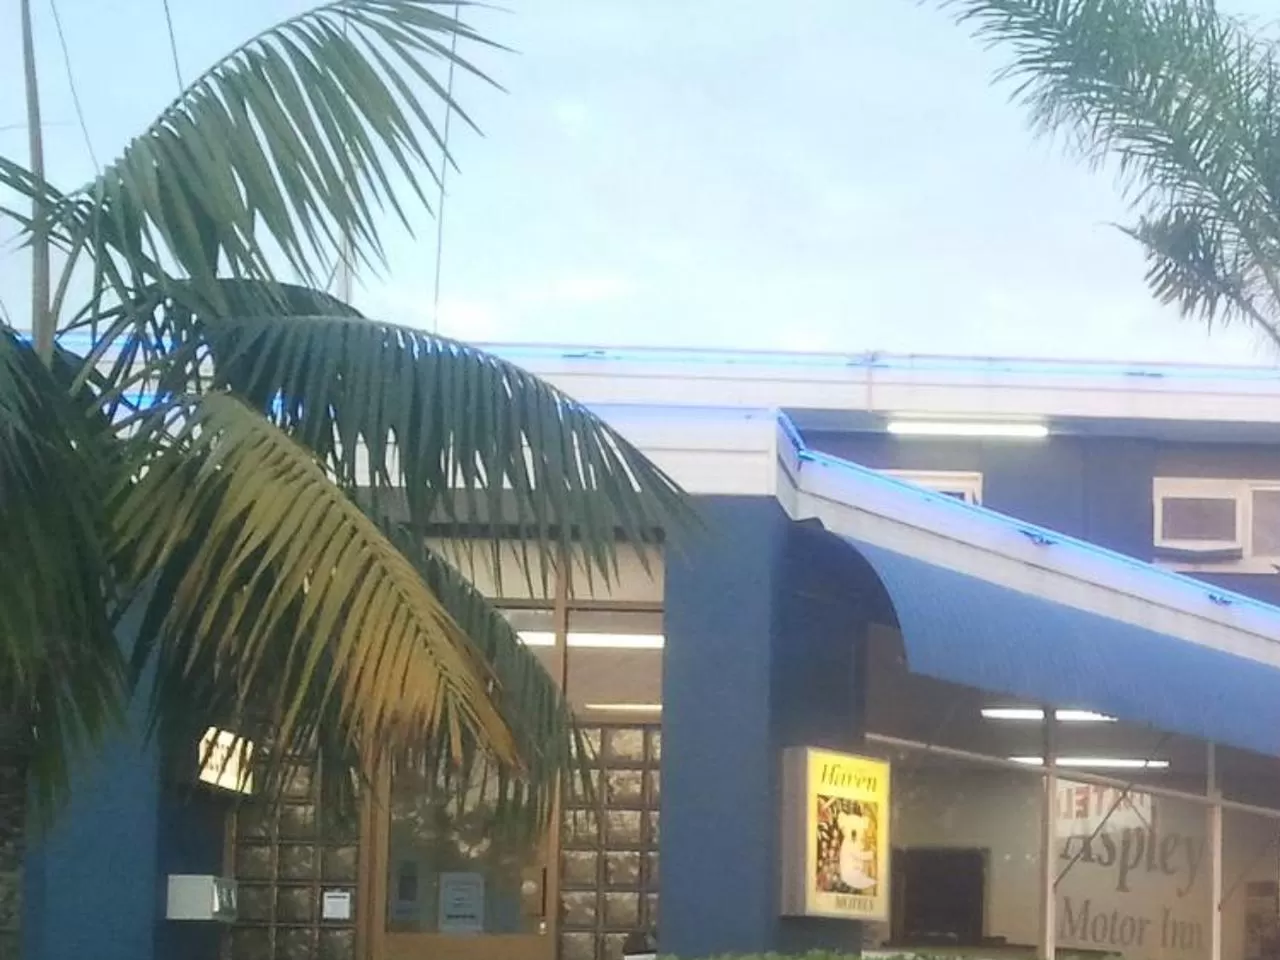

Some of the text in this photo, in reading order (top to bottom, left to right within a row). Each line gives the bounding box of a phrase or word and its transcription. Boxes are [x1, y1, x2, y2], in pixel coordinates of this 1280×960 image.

[821, 762, 878, 794] Haven
[1059, 804, 1206, 898] Aspley
[1060, 895, 1204, 951] Motor Inn
